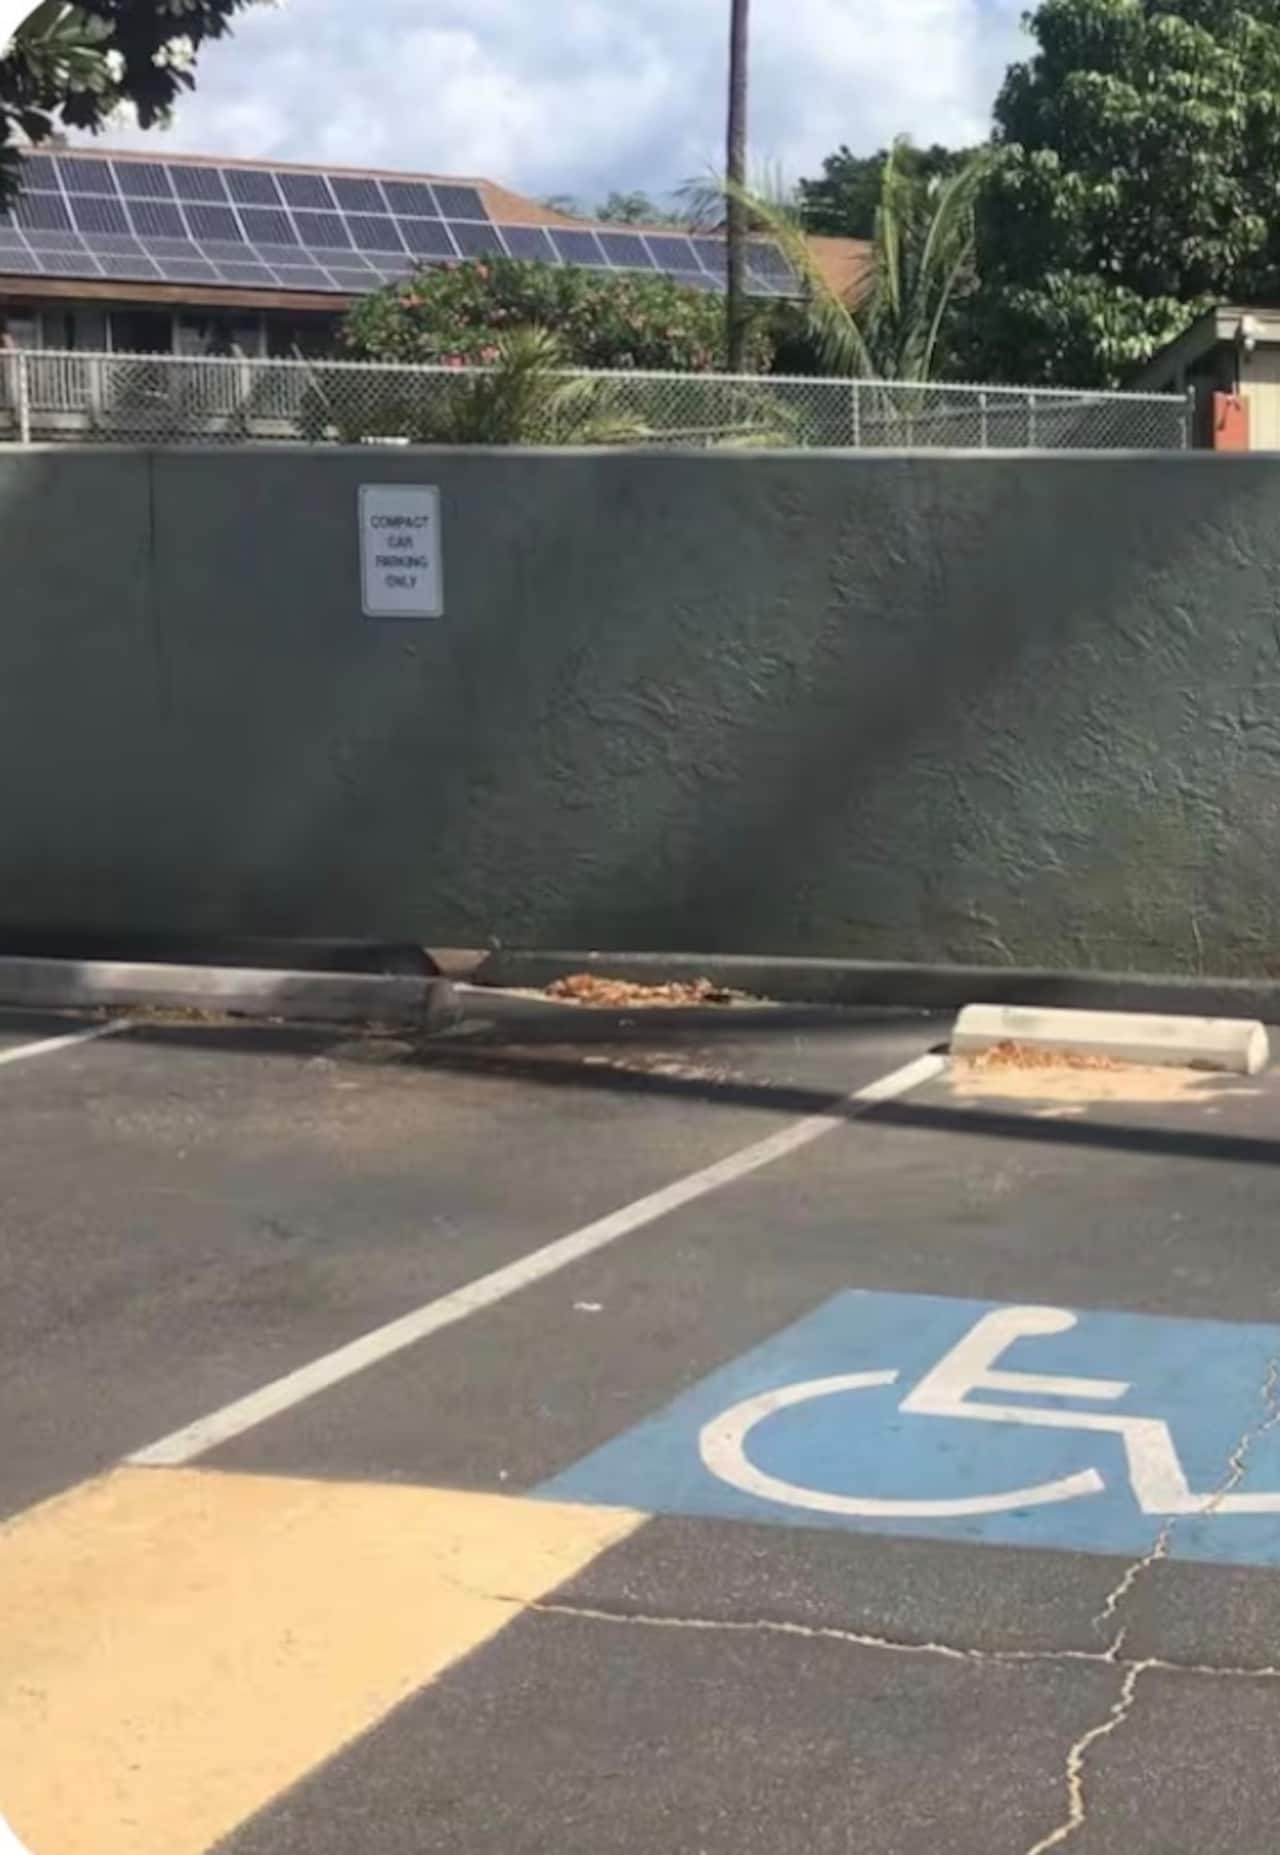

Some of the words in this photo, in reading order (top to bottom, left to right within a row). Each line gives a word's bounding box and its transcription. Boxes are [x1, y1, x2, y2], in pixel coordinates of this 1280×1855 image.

[370, 515, 428, 529] COMPACT
[387, 535, 414, 549] CAR
[375, 554, 429, 569] PARKING
[384, 574, 417, 588] ONLY
